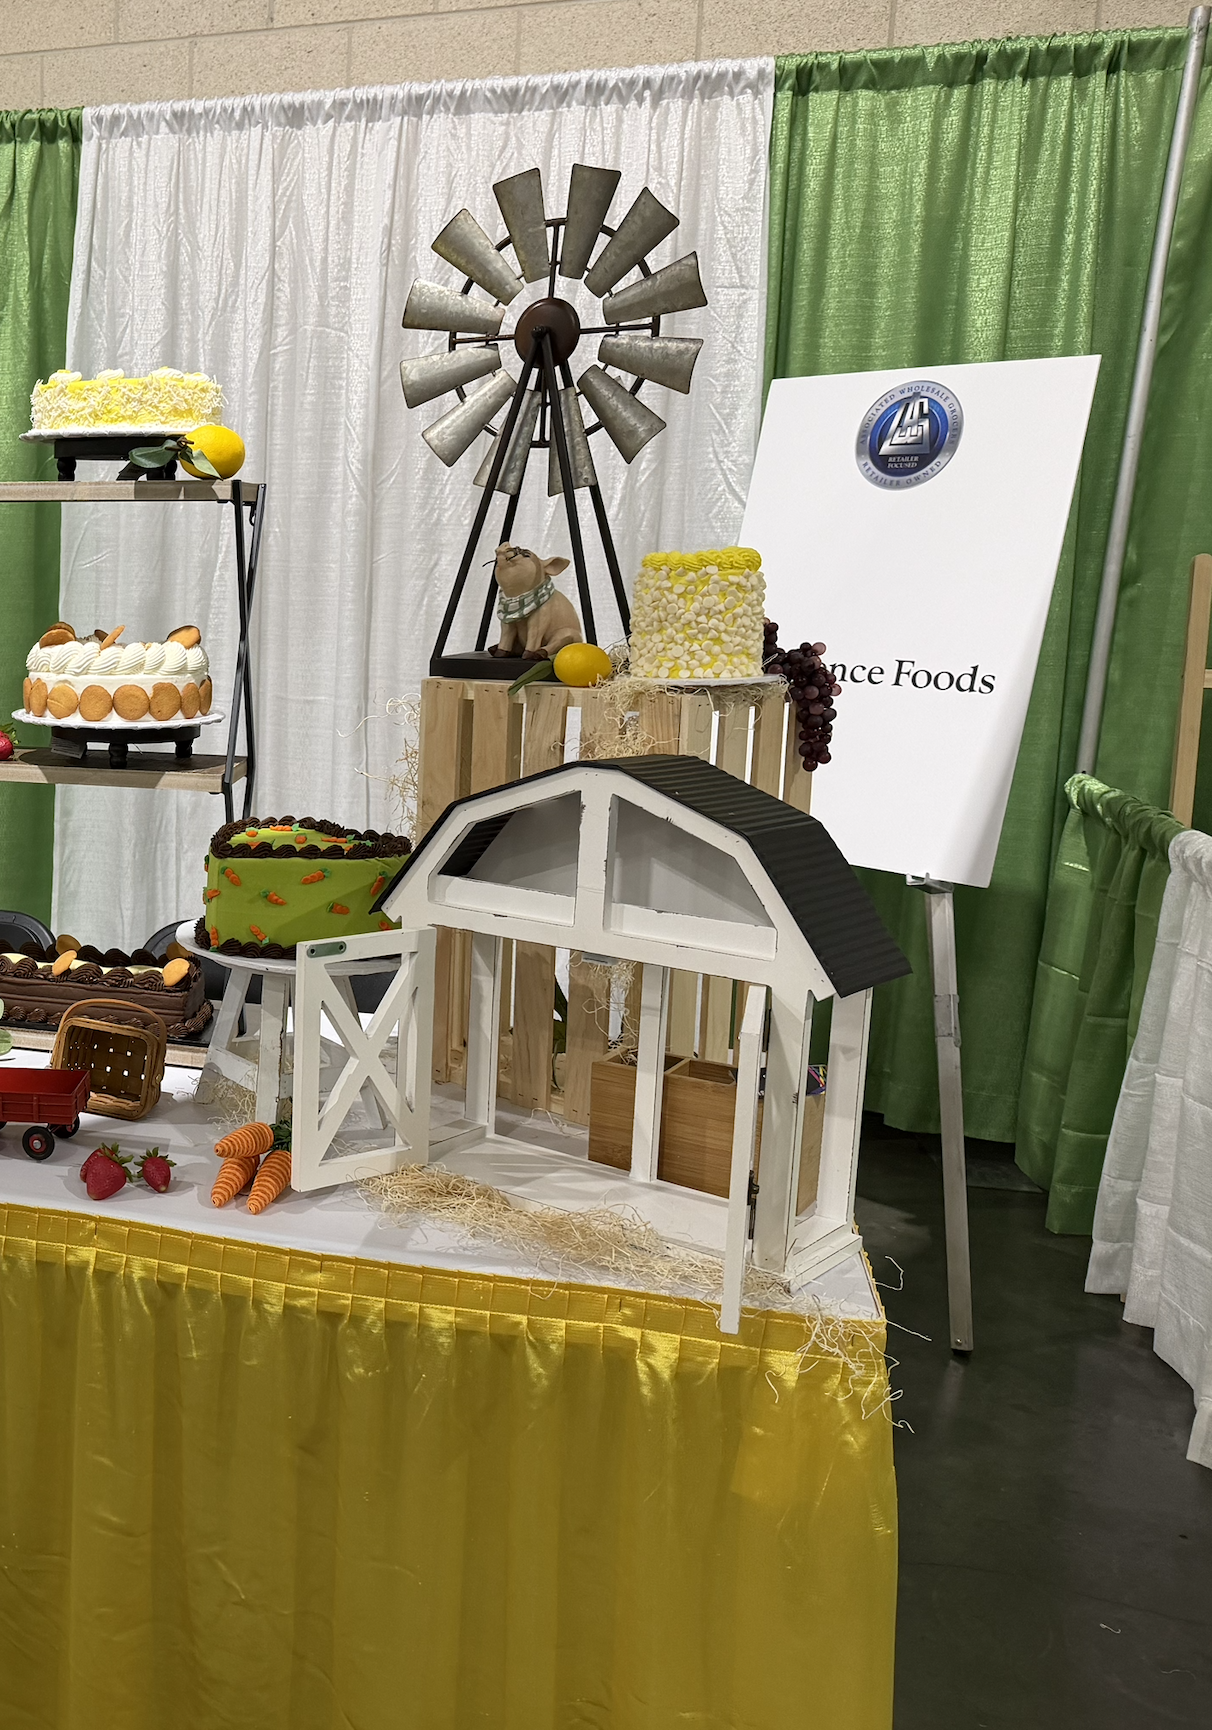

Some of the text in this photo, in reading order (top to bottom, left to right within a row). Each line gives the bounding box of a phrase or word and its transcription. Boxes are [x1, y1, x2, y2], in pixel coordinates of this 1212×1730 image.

[860, 394, 895, 444] ASSOCIATED
[899, 385, 950, 402] WHOLESALE
[862, 460, 942, 486] RETAILER OWNED
[820, 659, 996, 695] nce Foods
